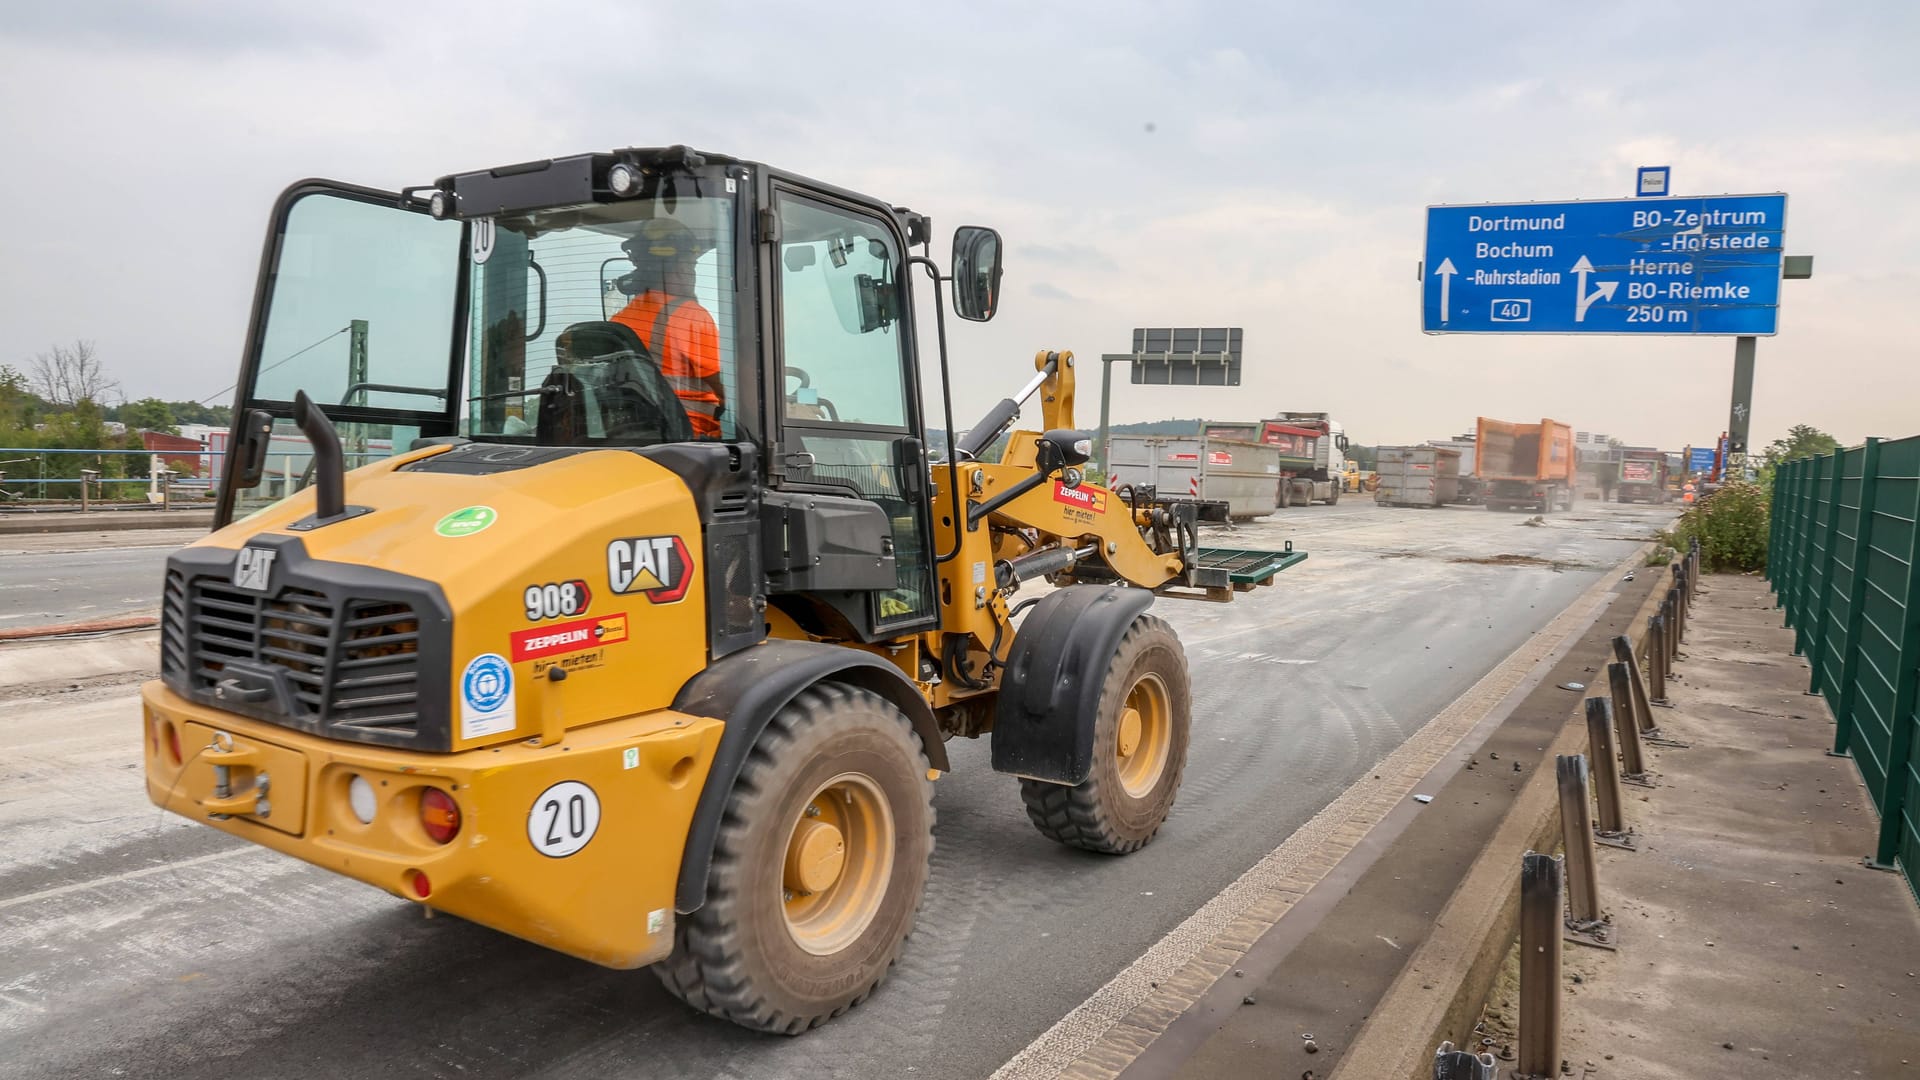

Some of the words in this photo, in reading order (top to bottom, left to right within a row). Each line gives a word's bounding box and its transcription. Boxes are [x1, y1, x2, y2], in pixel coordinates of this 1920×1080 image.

[1468, 213, 1565, 232] Dortmund
[1633, 209, 1766, 228] BO-Zentrum
[1476, 242, 1553, 258] Bochum
[1661, 232, 1770, 250] -Hofstede
[1629, 259, 1693, 275] Herne
[1466, 269, 1560, 285] -Ruhrstadion
[1628, 282, 1750, 299] BO-Riemke
[1501, 303, 1521, 317] 40
[1626, 306, 1664, 322] 250
[1668, 309, 1688, 322] m
[1060, 486, 1089, 502] ZEPPELIN
[234, 547, 277, 590] CAT
[607, 537, 674, 593] CAT
[525, 582, 577, 621] 908
[523, 628, 589, 651] ZEPPELIN
[544, 794, 585, 846] 20
